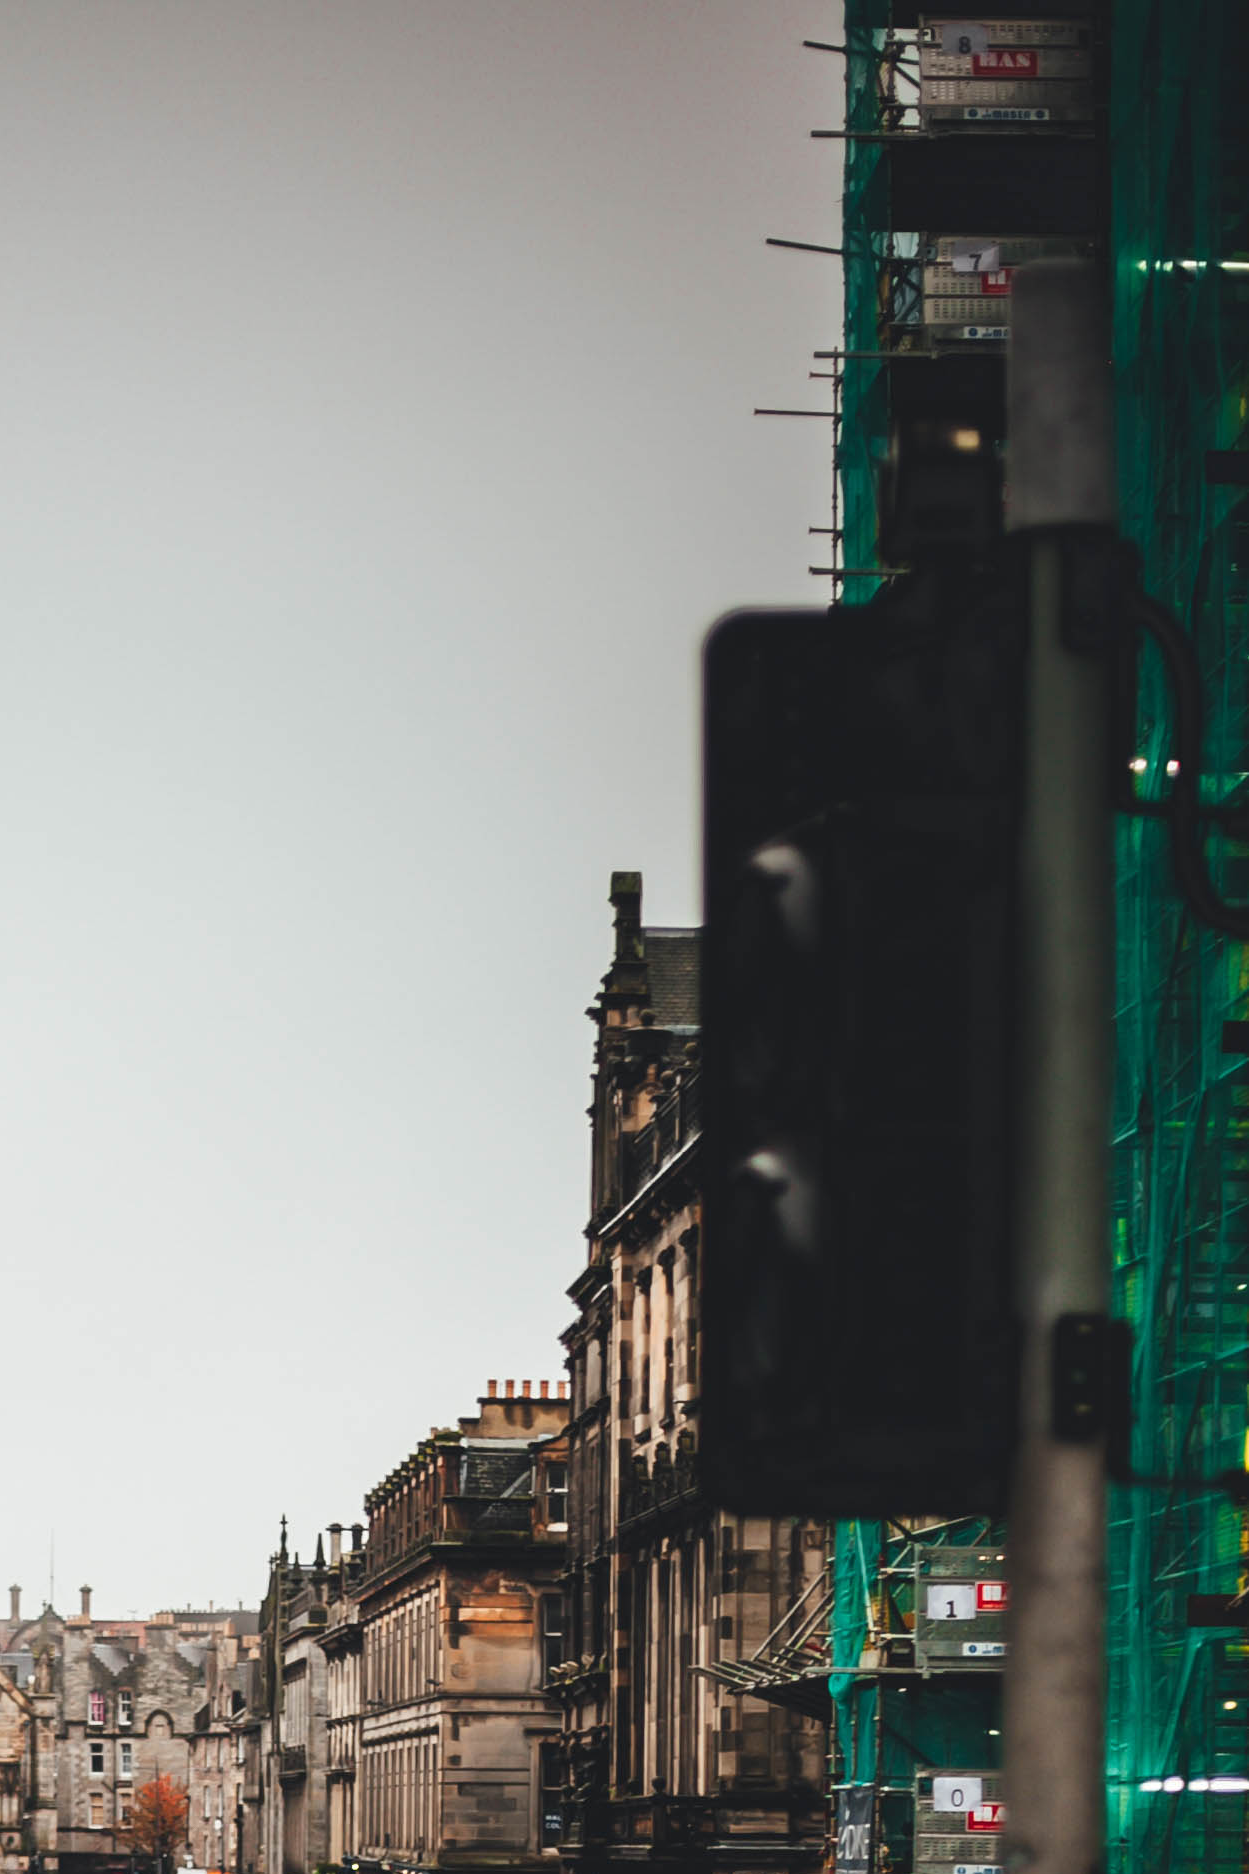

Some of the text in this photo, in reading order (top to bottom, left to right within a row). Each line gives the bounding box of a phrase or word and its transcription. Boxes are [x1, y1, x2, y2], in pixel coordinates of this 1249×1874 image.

[958, 36, 971, 55] 8
[969, 254, 982, 271] 7
[946, 1600, 958, 1618] 1
[951, 1788, 964, 1807] 0
